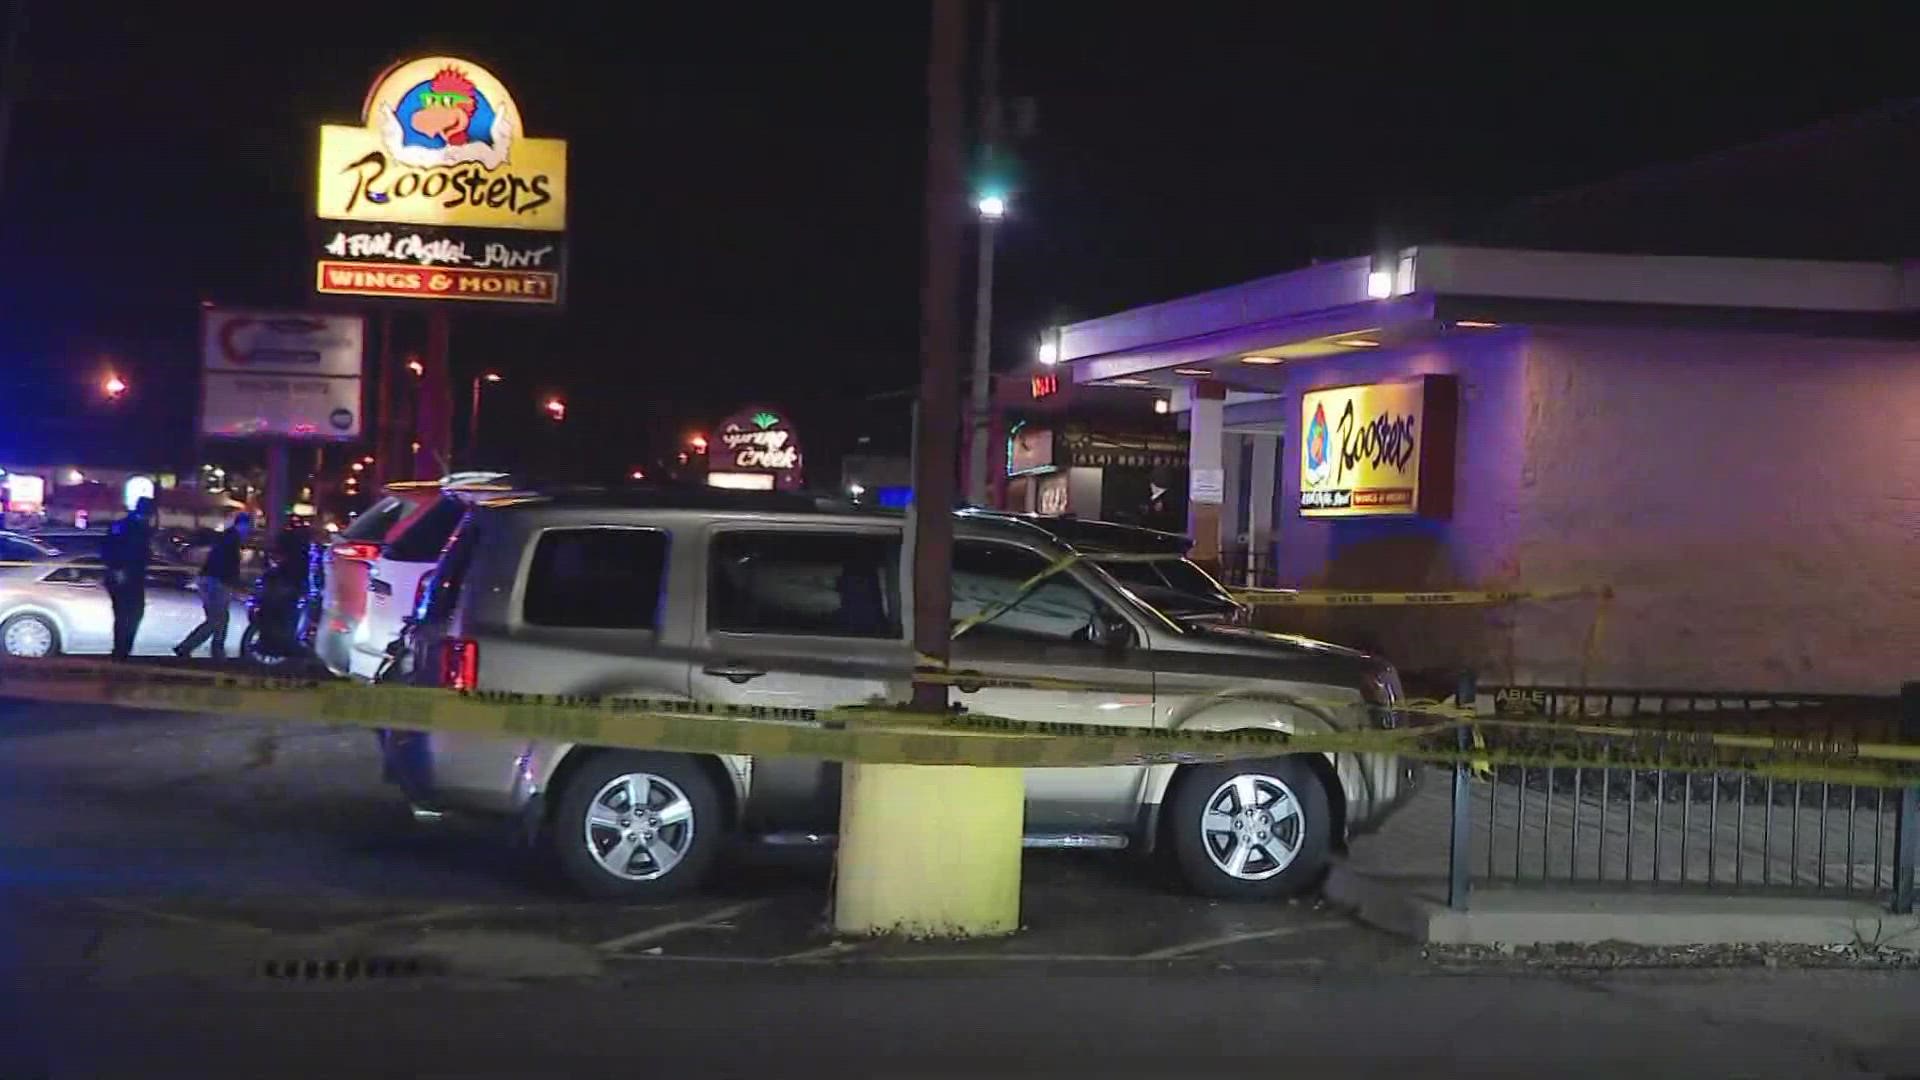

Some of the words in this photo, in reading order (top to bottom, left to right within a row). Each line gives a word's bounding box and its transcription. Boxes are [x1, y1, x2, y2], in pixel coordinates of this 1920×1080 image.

[341, 151, 552, 214] Roosters
[325, 231, 346, 256] A
[394, 234, 472, 265] CASUAL
[474, 244, 554, 268] JOINT
[328, 270, 422, 289] WINGS
[428, 274, 453, 291] &
[459, 279, 547, 294] MORE!
[1336, 399, 1415, 486] Roosters
